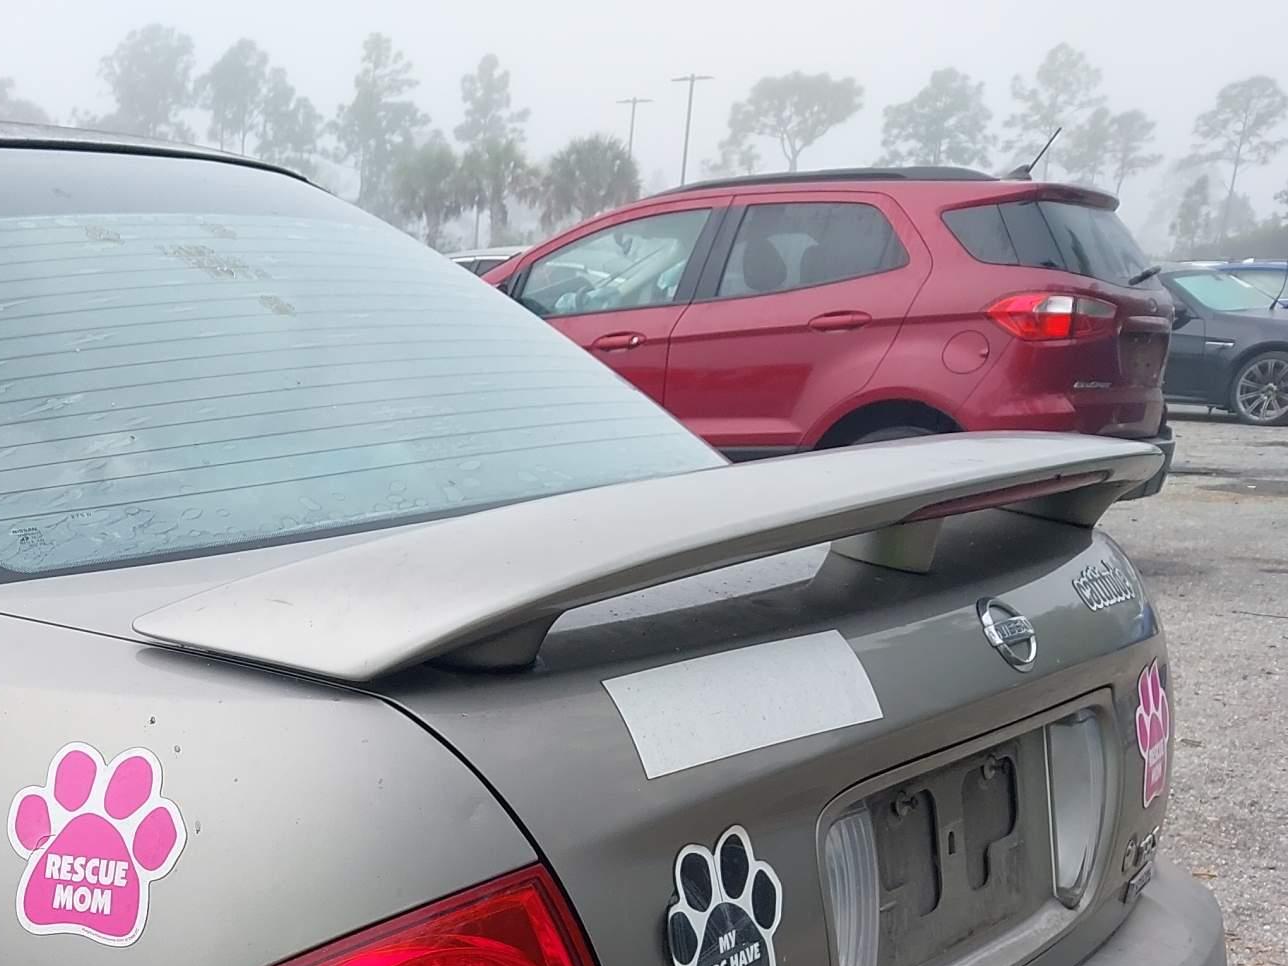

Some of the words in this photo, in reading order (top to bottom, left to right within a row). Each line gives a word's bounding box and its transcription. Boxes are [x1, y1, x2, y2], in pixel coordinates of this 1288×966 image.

[45, 853, 129, 887] RESCUE
[52, 883, 112, 915] MOM
[718, 929, 737, 954] MY
